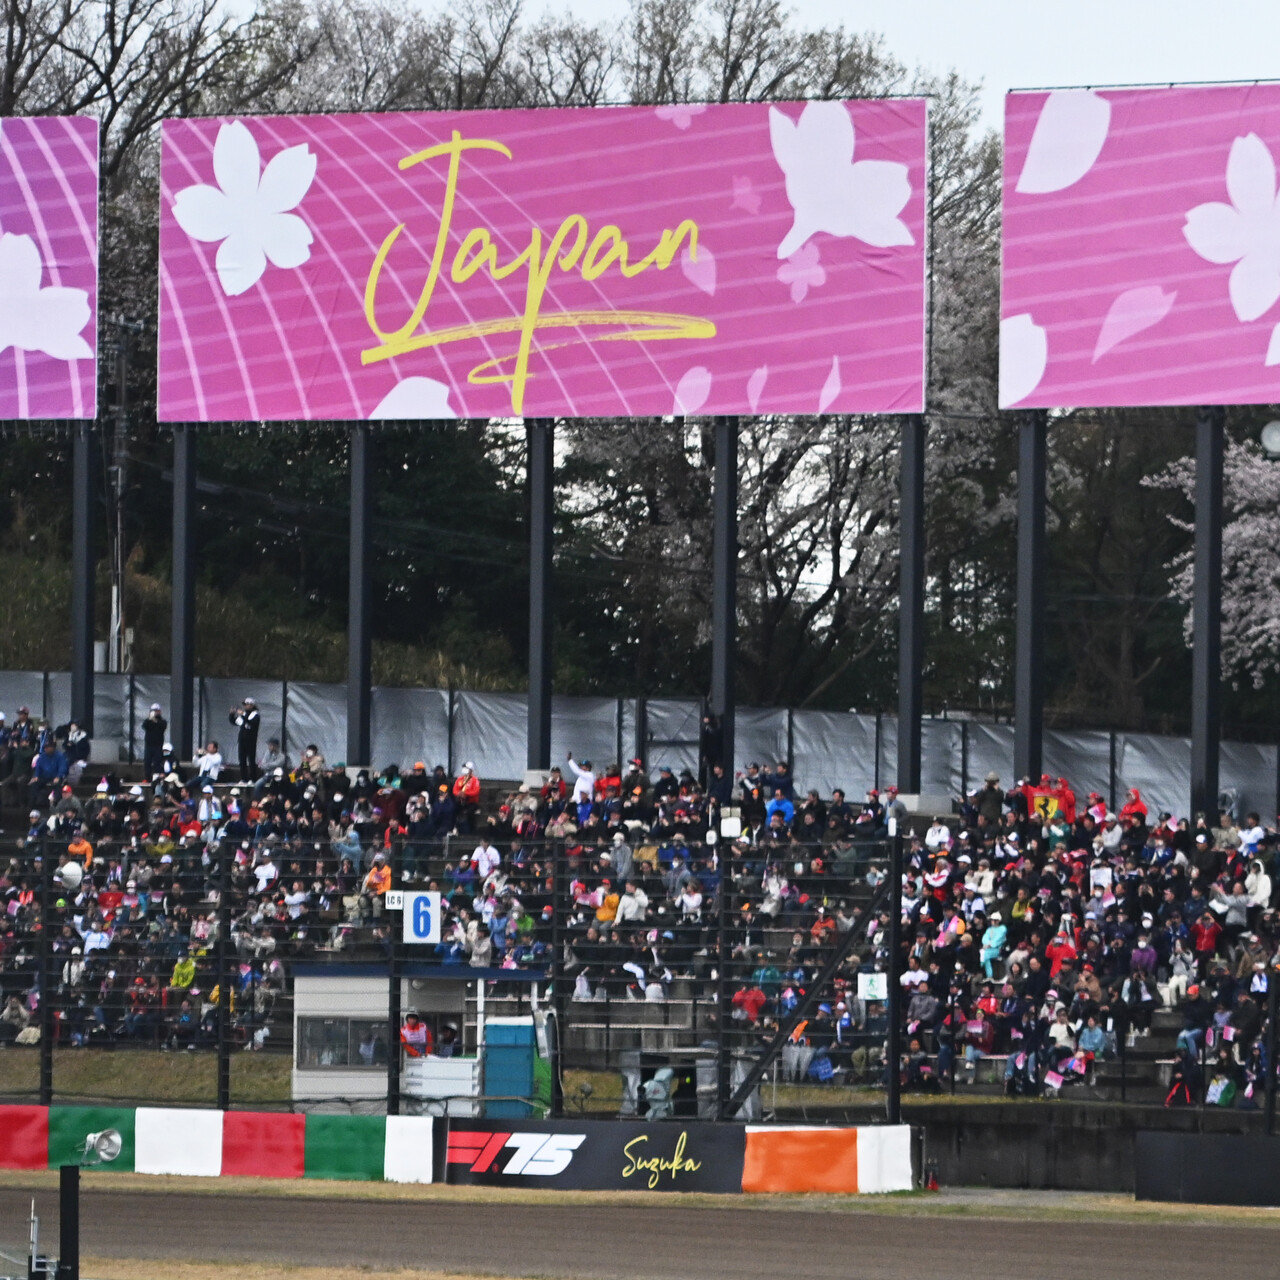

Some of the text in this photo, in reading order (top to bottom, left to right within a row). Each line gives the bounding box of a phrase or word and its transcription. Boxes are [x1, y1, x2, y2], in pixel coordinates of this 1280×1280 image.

[362, 129, 702, 415] Japan
[412, 895, 432, 939] 6
[621, 1130, 702, 1189] Suzuka
